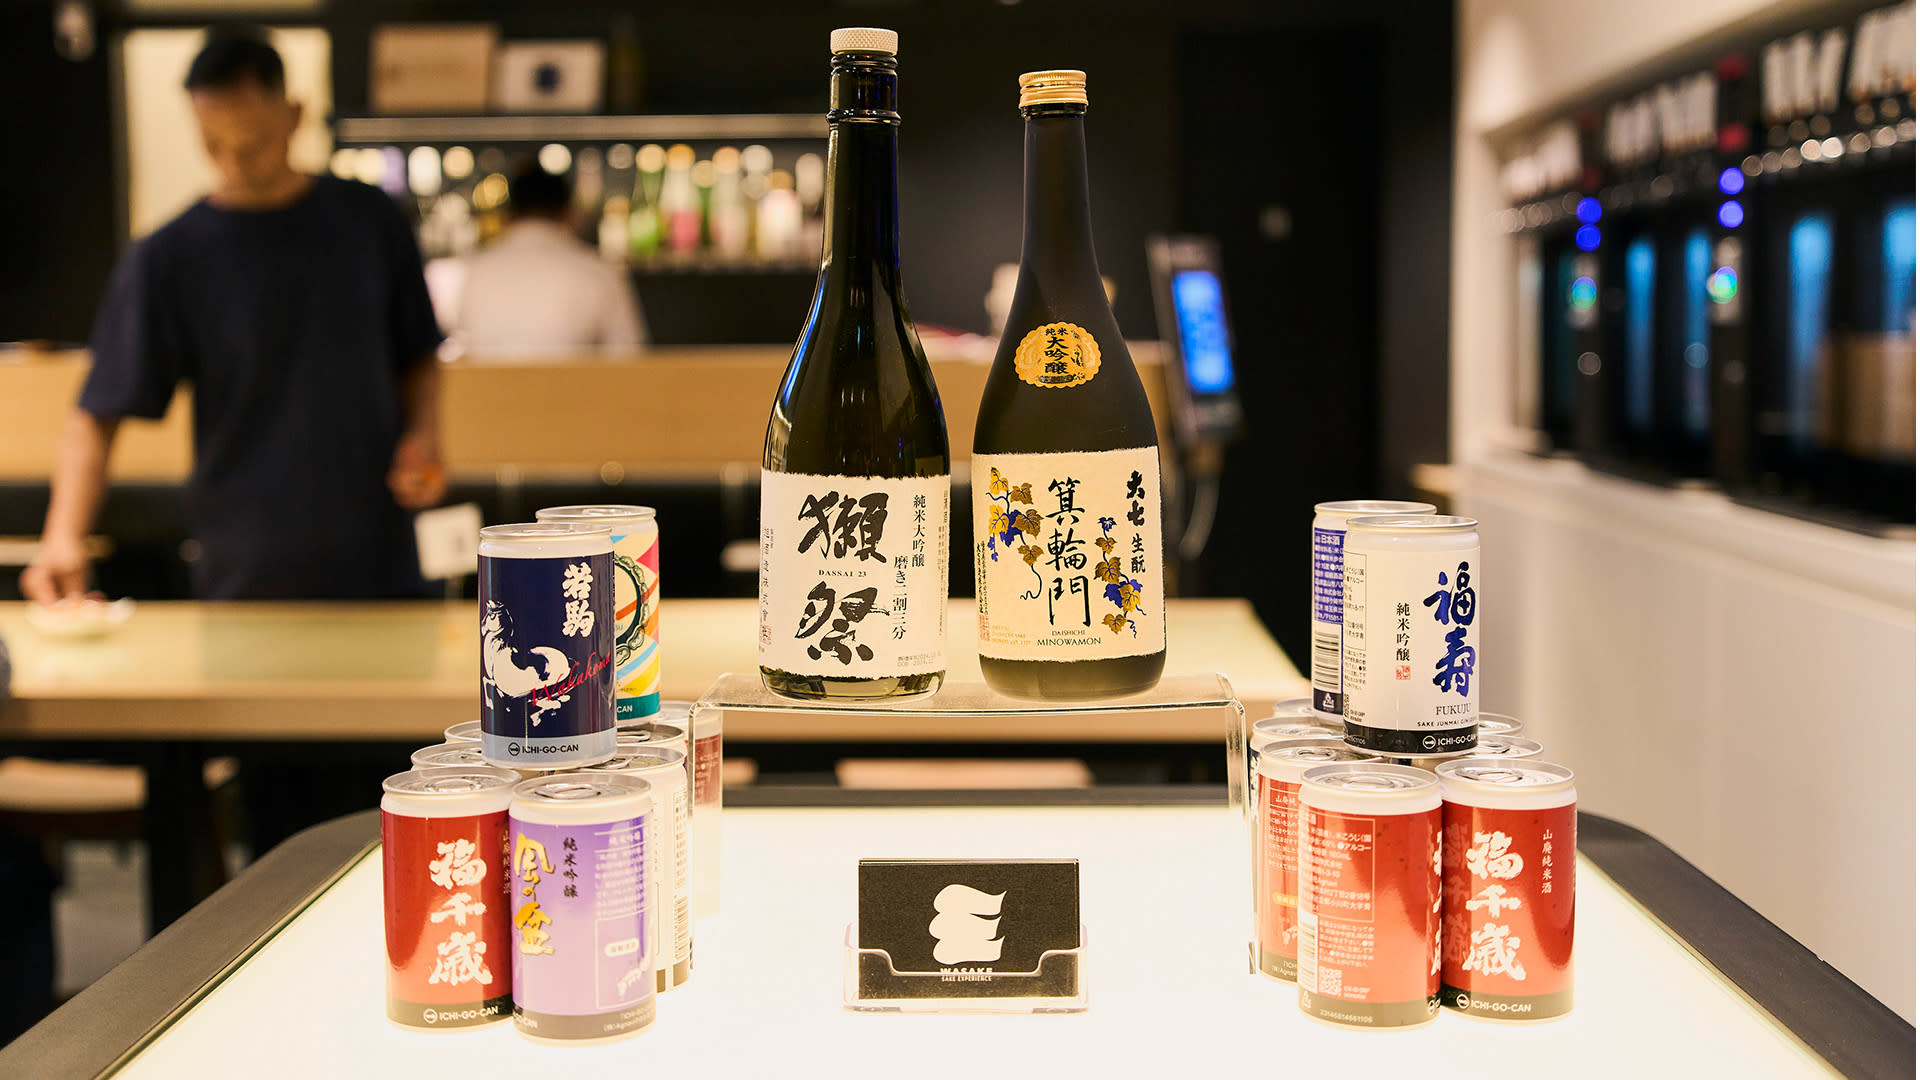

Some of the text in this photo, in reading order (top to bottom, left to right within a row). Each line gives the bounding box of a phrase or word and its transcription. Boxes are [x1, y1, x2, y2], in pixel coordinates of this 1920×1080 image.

[1045, 327, 1069, 336] 純米
[1044, 336, 1069, 374] 大吟醸
[911, 494, 927, 568] 純米大吟醸
[1044, 476, 1091, 627] 箕輪門
[818, 569, 854, 577] DASSAI
[562, 561, 595, 638] 若駒
[892, 555, 908, 640] 磨き二割三分
[1396, 603, 1411, 662] 純米吟醸
[1423, 560, 1477, 697] 福寿
[1037, 637, 1102, 646] MINOWAMON
[616, 704, 633, 713] CAN
[1435, 702, 1472, 716] FUKUJU
[522, 744, 579, 754] ICHI-GO-CAN
[439, 1005, 499, 1021] ICHI-GO-CAN
[1471, 999, 1532, 1012] ICHI-GO-CAN
